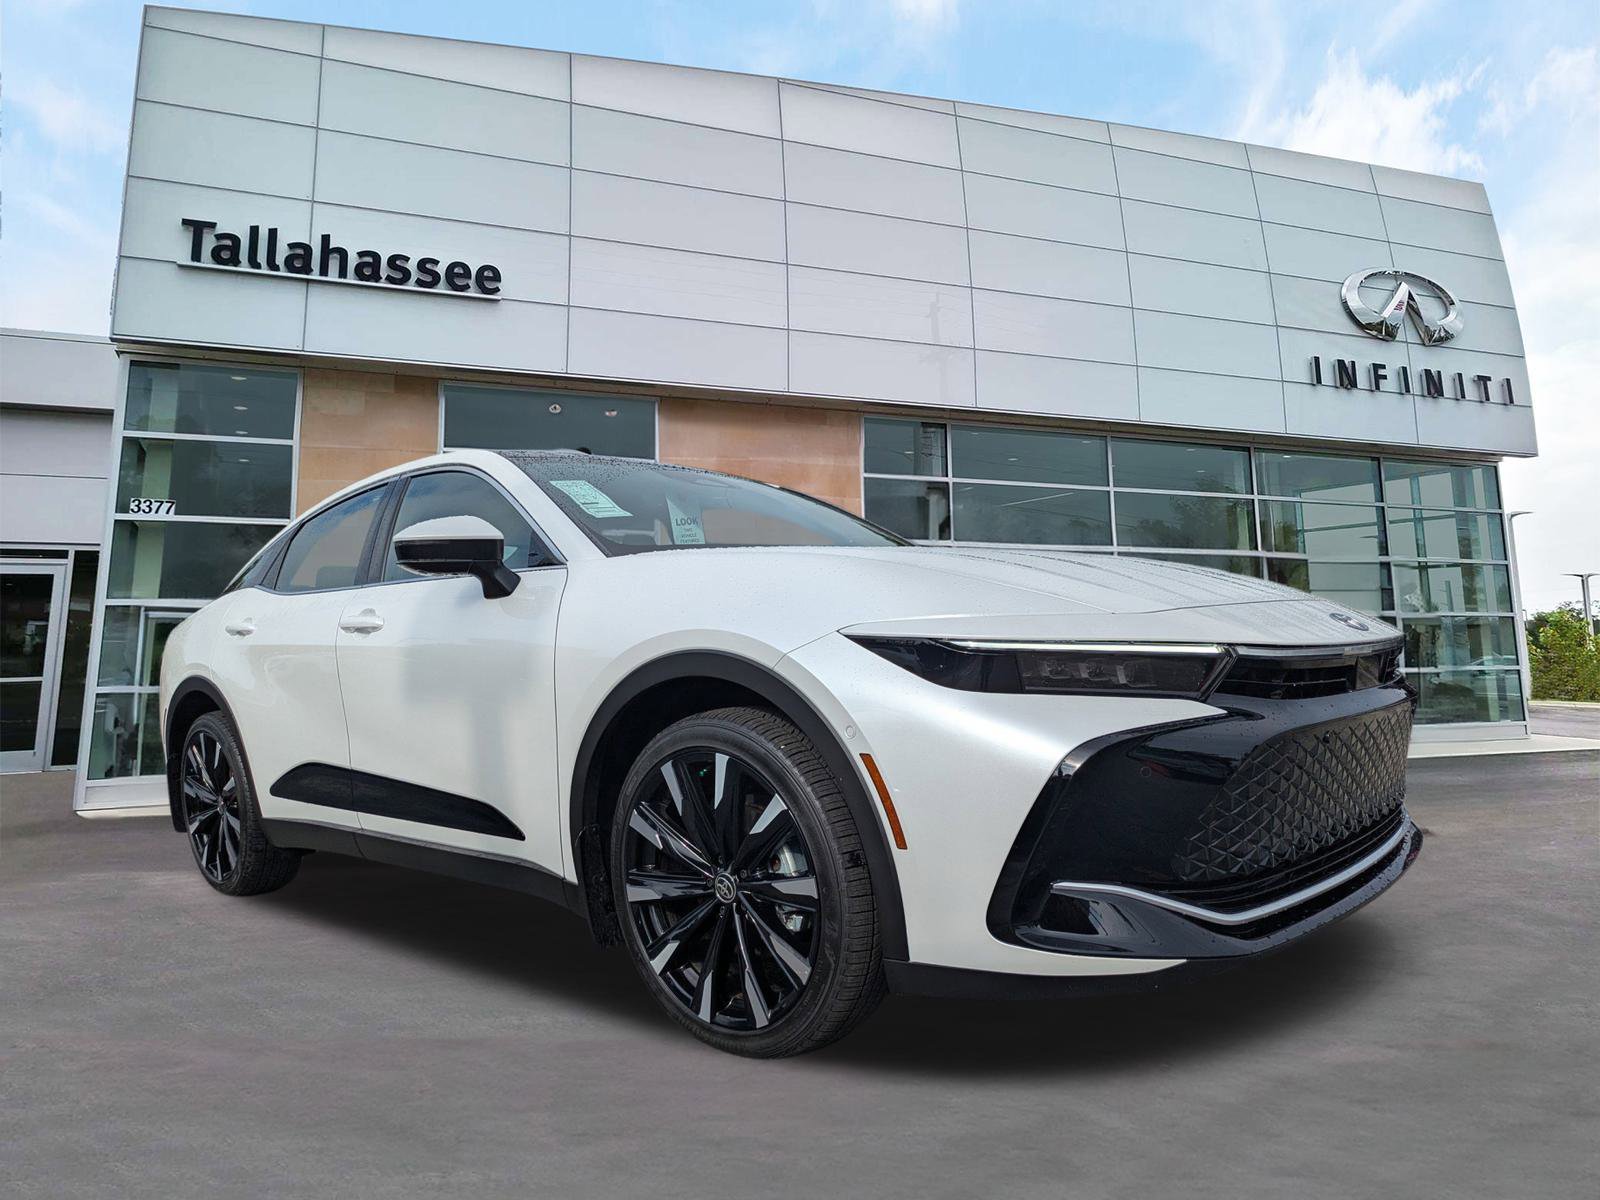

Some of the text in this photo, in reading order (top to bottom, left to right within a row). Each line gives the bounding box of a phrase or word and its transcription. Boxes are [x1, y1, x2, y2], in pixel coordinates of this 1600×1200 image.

[181, 217, 503, 295] Tallahassee
[1311, 356, 1515, 405] INFINITI
[130, 498, 176, 514] 3377
[674, 516, 698, 527] LOOK
